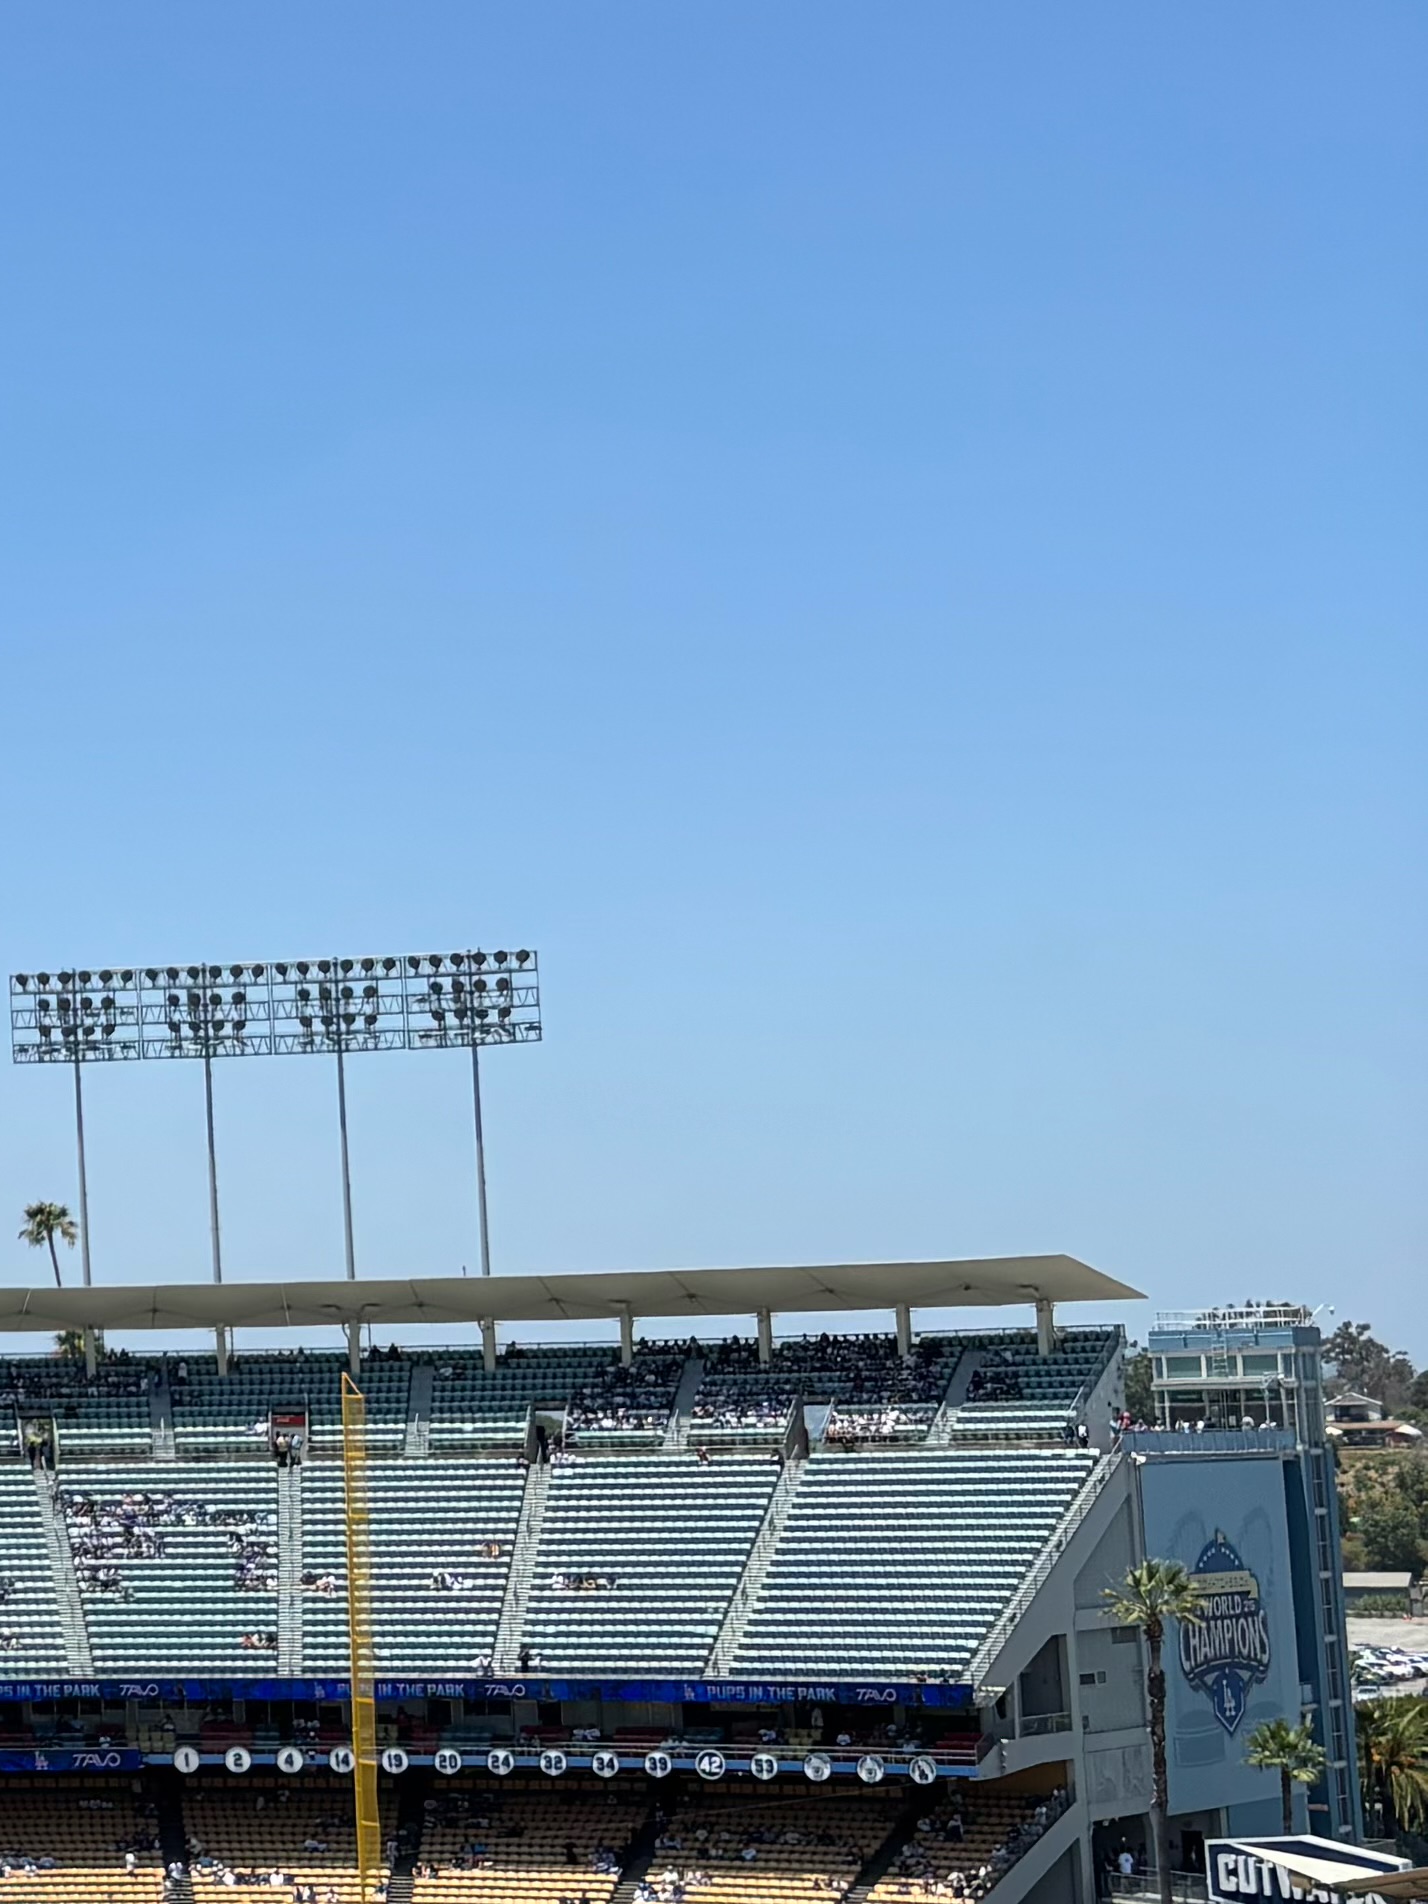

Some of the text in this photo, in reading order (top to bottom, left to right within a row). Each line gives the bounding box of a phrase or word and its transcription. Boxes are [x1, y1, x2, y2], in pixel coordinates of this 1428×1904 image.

[1203, 1595, 1242, 1617] WORLD
[1180, 1610, 1269, 1673] CHAMPIONS
[34, 1685, 61, 1697] THE
[64, 1684, 100, 1697] PARK
[378, 1683, 393, 1696] IN
[396, 1683, 424, 1696] THE
[427, 1683, 464, 1696] PARK
[707, 1686, 835, 1701] PUPS IN THE PARK
[856, 1689, 896, 1702] TAVO
[72, 1752, 121, 1768] TAVO
[183, 1753, 190, 1767] 1
[233, 1753, 243, 1767] 2
[284, 1753, 294, 1767] 4
[334, 1753, 350, 1768] 14
[387, 1754, 403, 1768] 19
[439, 1755, 458, 1769] 20
[491, 1755, 510, 1769] 24
[544, 1756, 563, 1771] 32
[595, 1756, 615, 1772] 34
[648, 1756, 667, 1772] 39
[700, 1756, 721, 1772] 42
[754, 1758, 774, 1773] 53
